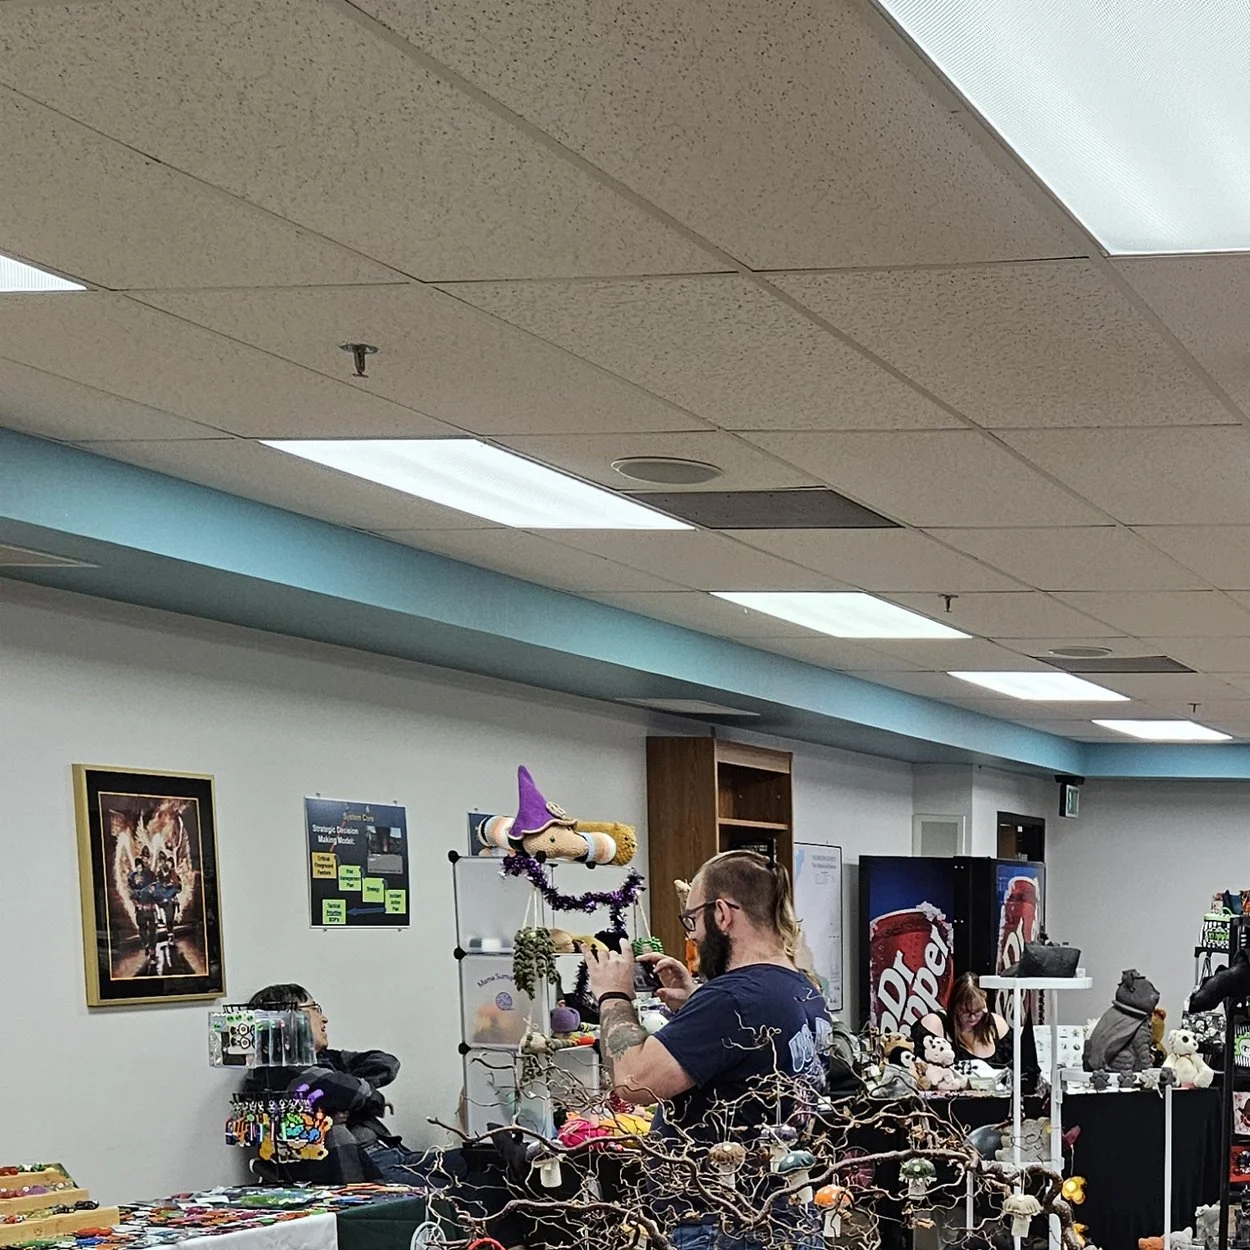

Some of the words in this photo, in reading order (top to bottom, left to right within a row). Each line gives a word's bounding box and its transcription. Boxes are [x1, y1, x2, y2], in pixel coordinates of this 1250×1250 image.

[312, 823, 336, 835] Strategic
[336, 826, 359, 835] Decision
[317, 835, 337, 845] Making
[877, 950, 915, 1020] Dr
